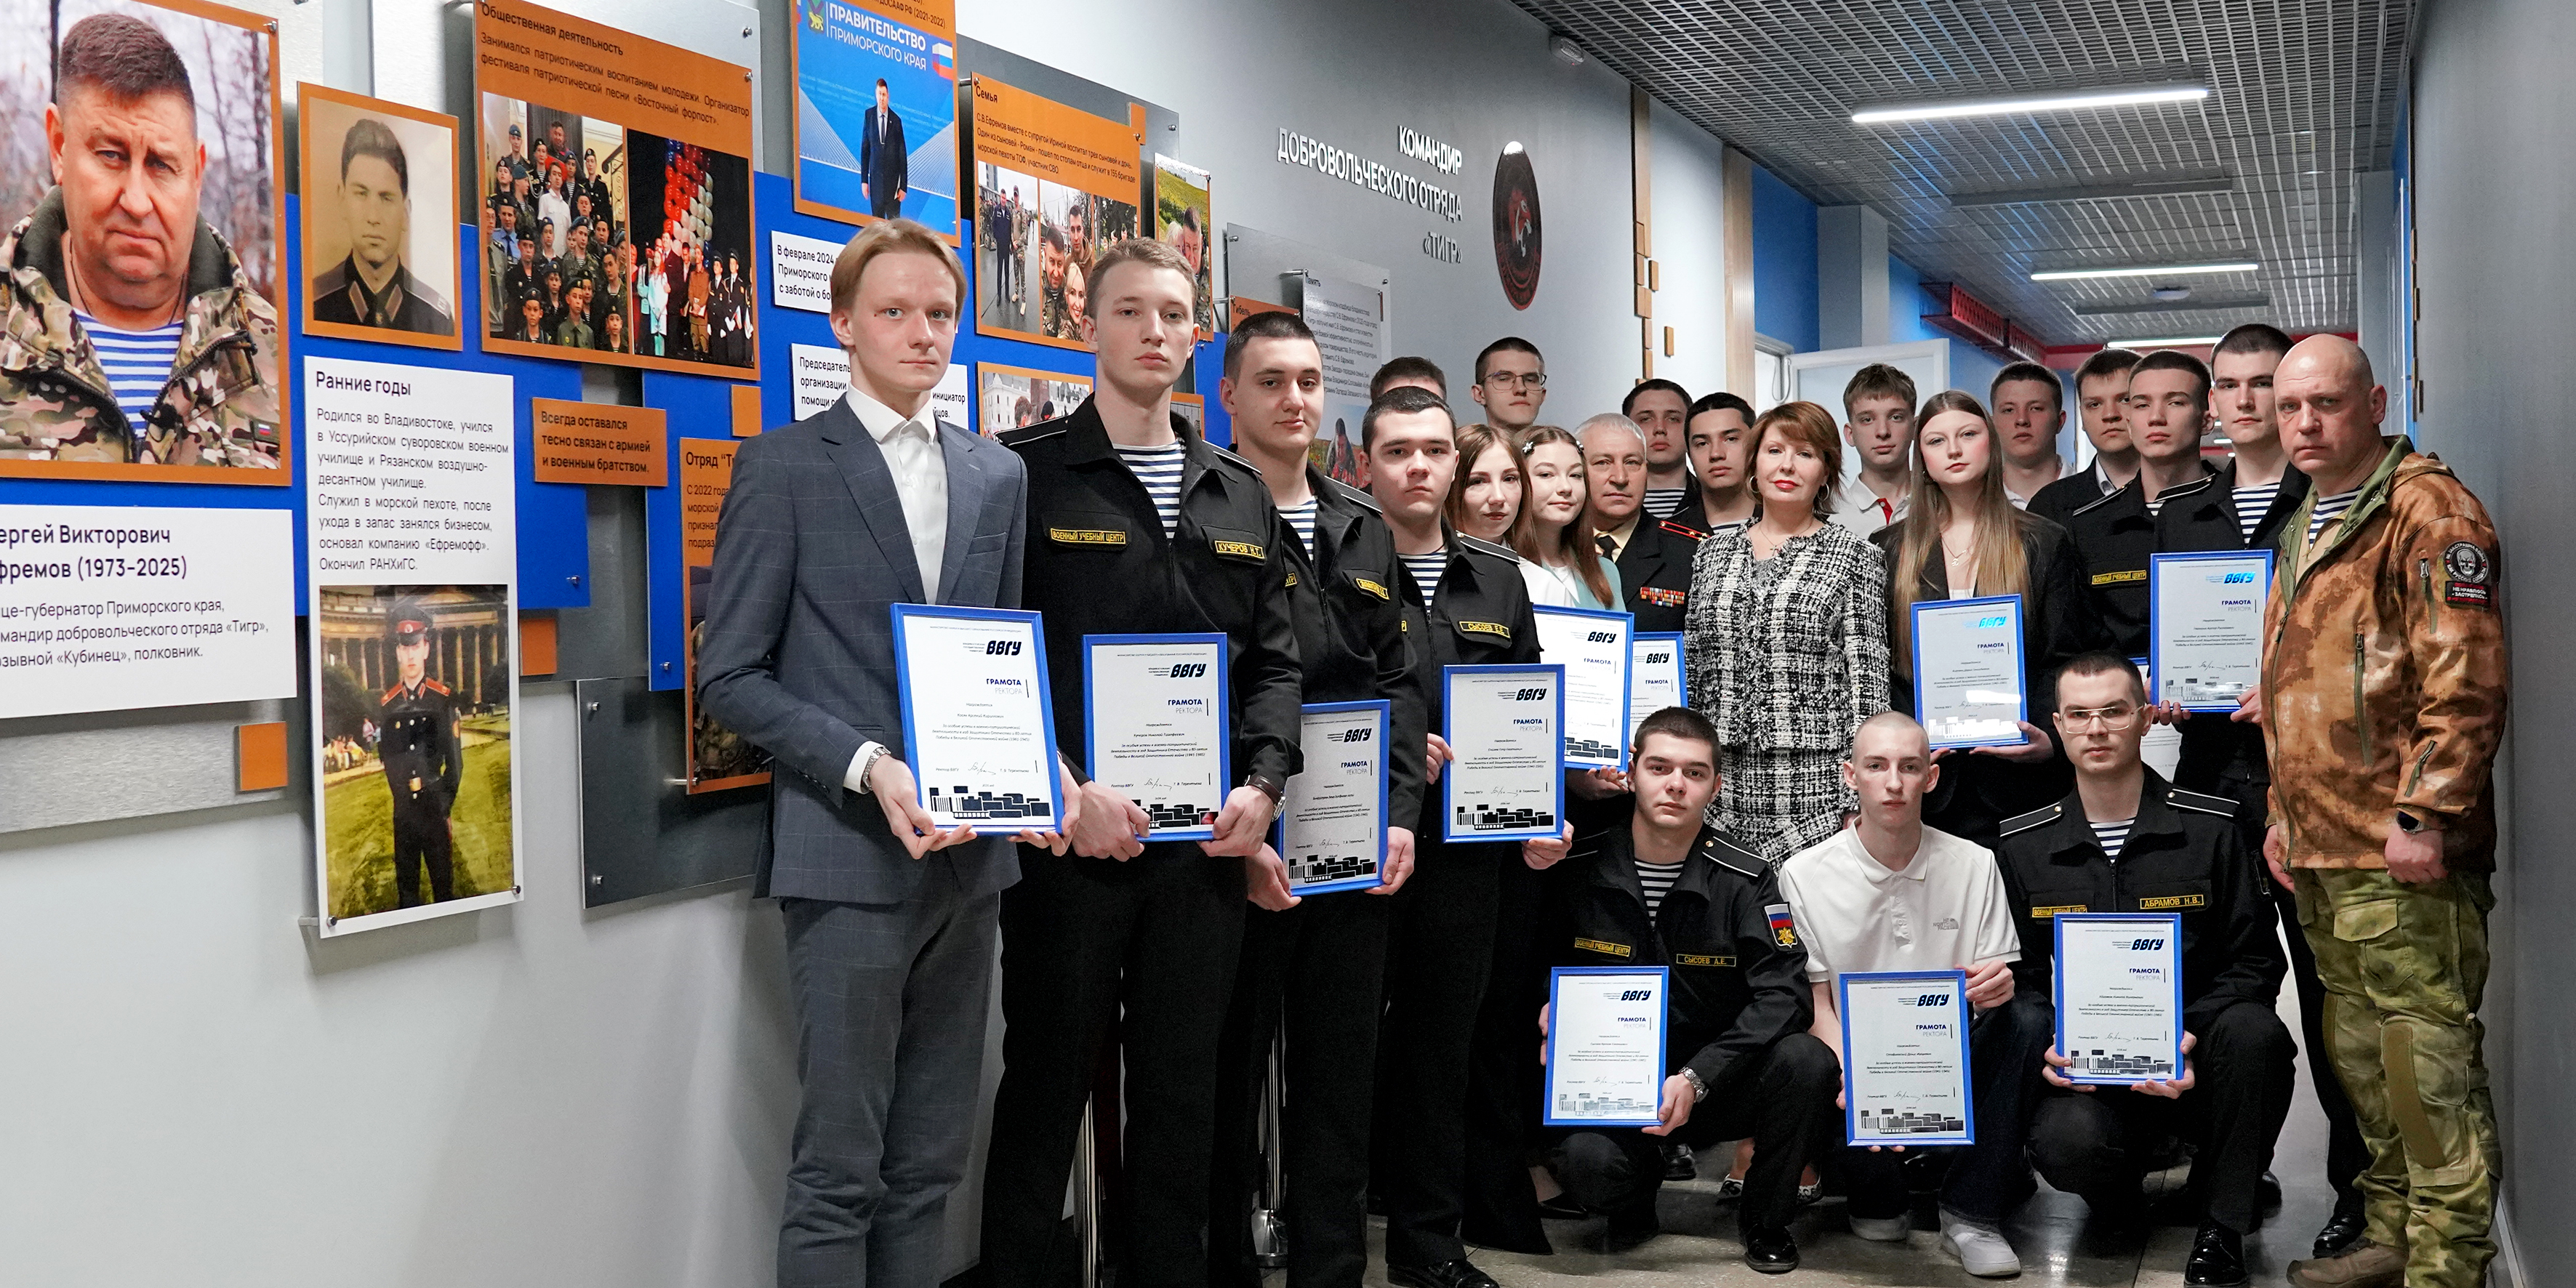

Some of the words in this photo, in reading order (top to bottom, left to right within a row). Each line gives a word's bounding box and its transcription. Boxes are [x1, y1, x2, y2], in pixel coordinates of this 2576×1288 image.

[904, 7, 912, 15] РФ
[481, 4, 556, 35] Общественная
[559, 27, 624, 55] деятельность
[830, 4, 926, 51] ПРАВИТЕЛЬСТВО
[830, 25, 902, 63] ПРИМОРСКОГО
[904, 52, 926, 71] КРАЯ
[481, 32, 531, 55] Занимался
[534, 49, 603, 76] патриотическим
[607, 70, 658, 92] воспитанием
[704, 94, 750, 118] Организатор
[481, 53, 529, 74] фестиваля
[534, 68, 602, 93] патриотической
[606, 87, 630, 100] песни
[634, 94, 678, 115] «Восточный
[976, 86, 998, 103] Семья
[977, 127, 990, 138] Один
[997, 135, 1016, 147] сыновей
[1020, 141, 1035, 153] Роман
[1008, 125, 1024, 135] вместе
[1028, 132, 1048, 143] супругой
[1067, 144, 1088, 156] воспитал
[977, 144, 998, 155] морской
[999, 150, 1015, 160] пехоты
[1399, 125, 1462, 174] КОМАНДИР
[1278, 126, 1416, 204] ДОБРОВОЛЬЧЕСКОГО
[1419, 181, 1462, 222] ОТРЯДА
[777, 246, 782, 255] В
[784, 247, 815, 262] феврале
[816, 251, 834, 265] 2024
[1424, 231, 1462, 263] «ТИГР»
[778, 264, 827, 282] Приморского
[785, 284, 815, 297] заботой
[316, 371, 372, 393] Ранние
[376, 381, 412, 397] годы
[801, 378, 846, 390] организации
[801, 397, 830, 407] помощи
[933, 393, 966, 405] инициатор
[317, 408, 362, 423] Родился
[367, 414, 379, 423] во
[384, 414, 455, 431] Владивостоке,
[460, 422, 493, 434] учился
[541, 411, 576, 426] Всегда
[578, 418, 627, 430] оставался
[329, 430, 396, 447] Уссурийском
[401, 437, 464, 451] суворовском
[469, 443, 509, 454] военном
[542, 435, 571, 446] тесно
[574, 439, 606, 449] связан
[609, 440, 614, 449] с
[616, 440, 650, 453] армией
[318, 454, 364, 466] училище
[380, 455, 433, 468] Рязанском
[438, 462, 488, 472] воздушно-
[542, 456, 548, 465] и
[551, 456, 595, 469] военным
[597, 458, 649, 473] братством.
[686, 452, 718, 469] Отряд
[318, 475, 375, 486] десантном
[381, 478, 426, 490] училище.
[687, 485, 692, 494] С
[694, 486, 712, 495] 2022
[318, 494, 359, 509] Служил
[365, 497, 371, 506] в
[376, 497, 418, 510] морской
[423, 500, 458, 512] пехоте,
[464, 502, 491, 510] после
[688, 503, 718, 515] морской
[318, 518, 349, 531] ухода
[355, 519, 361, 528] в
[366, 519, 394, 528] запас
[400, 520, 439, 530] занялся
[444, 519, 492, 532] бизнесом,
[60, 524, 170, 549] Викторович
[320, 539, 363, 549] основал
[369, 540, 420, 550] компанию
[425, 538, 489, 552] «Ефремофф».
[1053, 531, 1078, 541] ВОЕННЫЙ
[1079, 531, 1105, 541] УЧЕБНЫЙ
[1106, 534, 1123, 542] ЦЕНТР
[1219, 544, 1248, 552] КУЧЕРОВ
[78, 555, 187, 581] (1973-2025)
[320, 558, 364, 570] Окончил
[371, 558, 417, 570] РАНХиГС.
[2223, 571, 2255, 584] ВВГУ
[107, 600, 190, 618] Приморского
[194, 600, 225, 615] края,
[0, 629, 52, 645] мандир
[57, 625, 177, 643] добровольческого
[181, 621, 222, 636] отряда
[226, 619, 269, 635] «Тигр»,
[1588, 632, 1616, 643] ВВГУ
[0, 651, 52, 667] зывной
[57, 648, 131, 667] «Кубинец»,
[135, 646, 203, 661] полковник.
[986, 640, 1022, 656] ВВГУ
[1646, 653, 1669, 664] ВВГУ
[1171, 664, 1206, 677] ВВГУ
[1516, 689, 1547, 701] ВВГУ
[1344, 728, 1372, 743] ВВГУ
[2145, 898, 2180, 907] АБРАМОВ
[2132, 939, 2164, 951] ВВГУ
[1621, 990, 1651, 1001] ВВГУ
[1917, 994, 1950, 1006] ВВГУ
